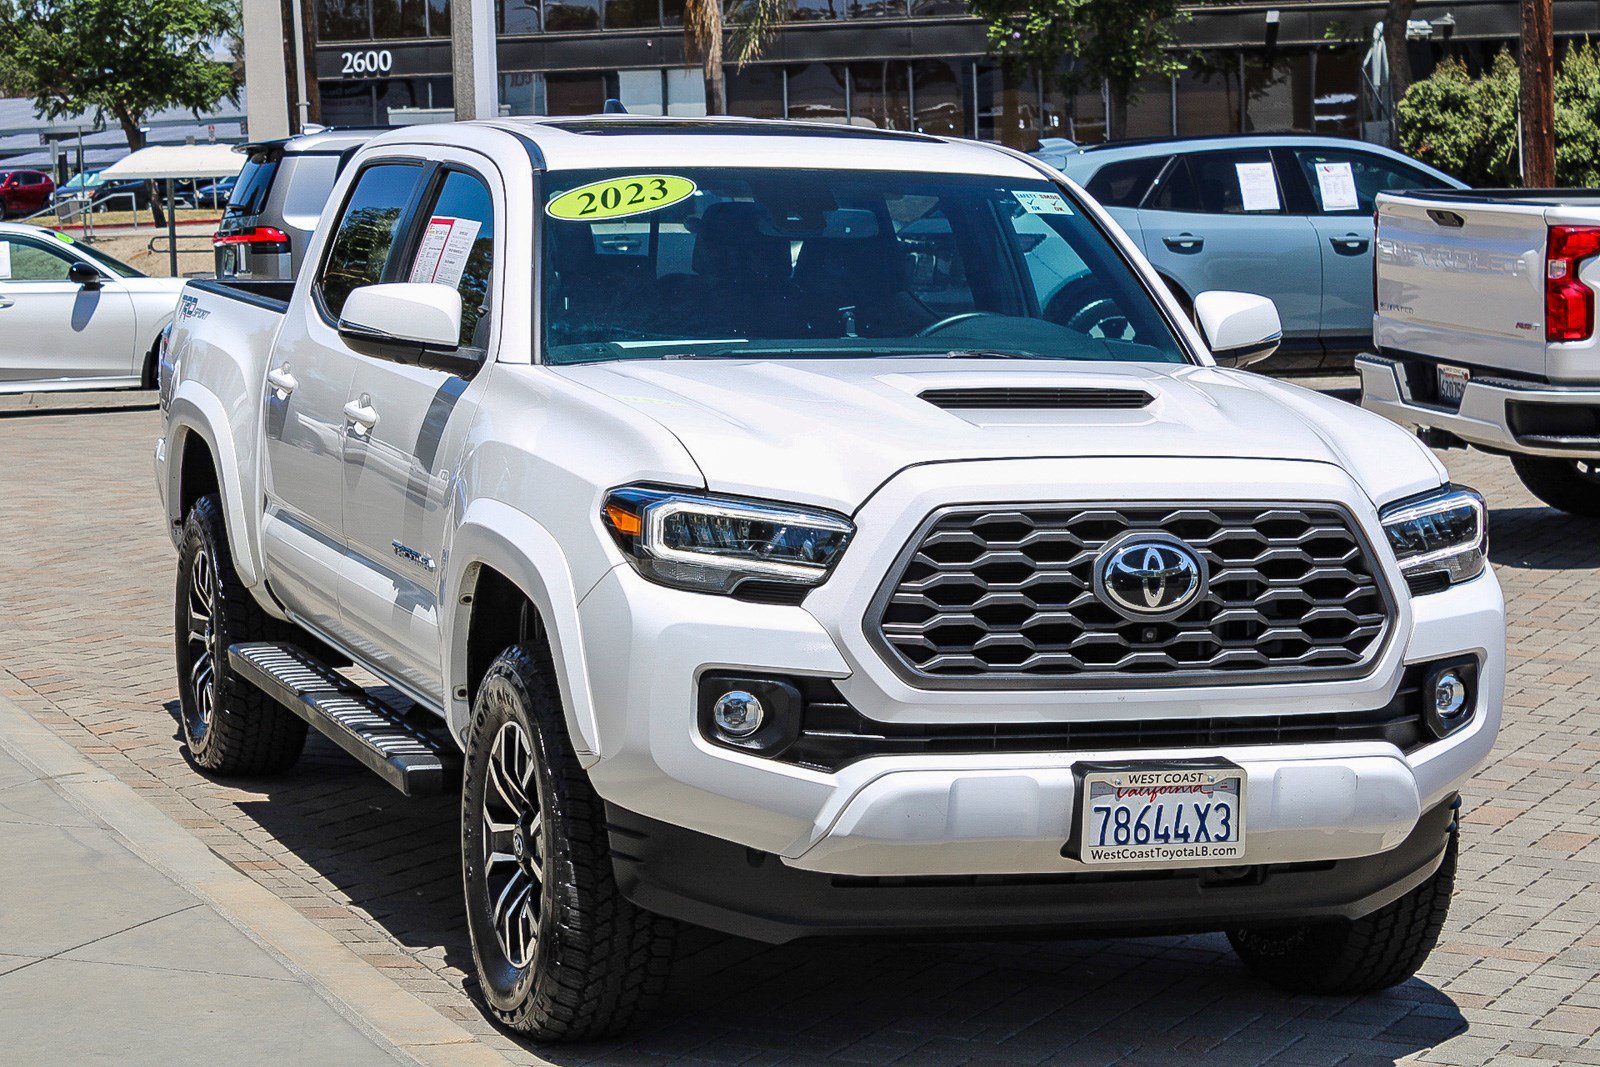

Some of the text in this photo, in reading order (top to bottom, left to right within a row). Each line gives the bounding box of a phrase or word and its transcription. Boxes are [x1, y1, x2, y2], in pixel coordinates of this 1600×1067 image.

[341, 50, 392, 73] 2600
[577, 179, 668, 215] 2023
[1128, 772, 1204, 784] WEST COAST
[1117, 784, 1214, 803] California
[1093, 802, 1231, 846] 78644X3
[1091, 846, 1237, 861] WestCoastToyotaLB.com
